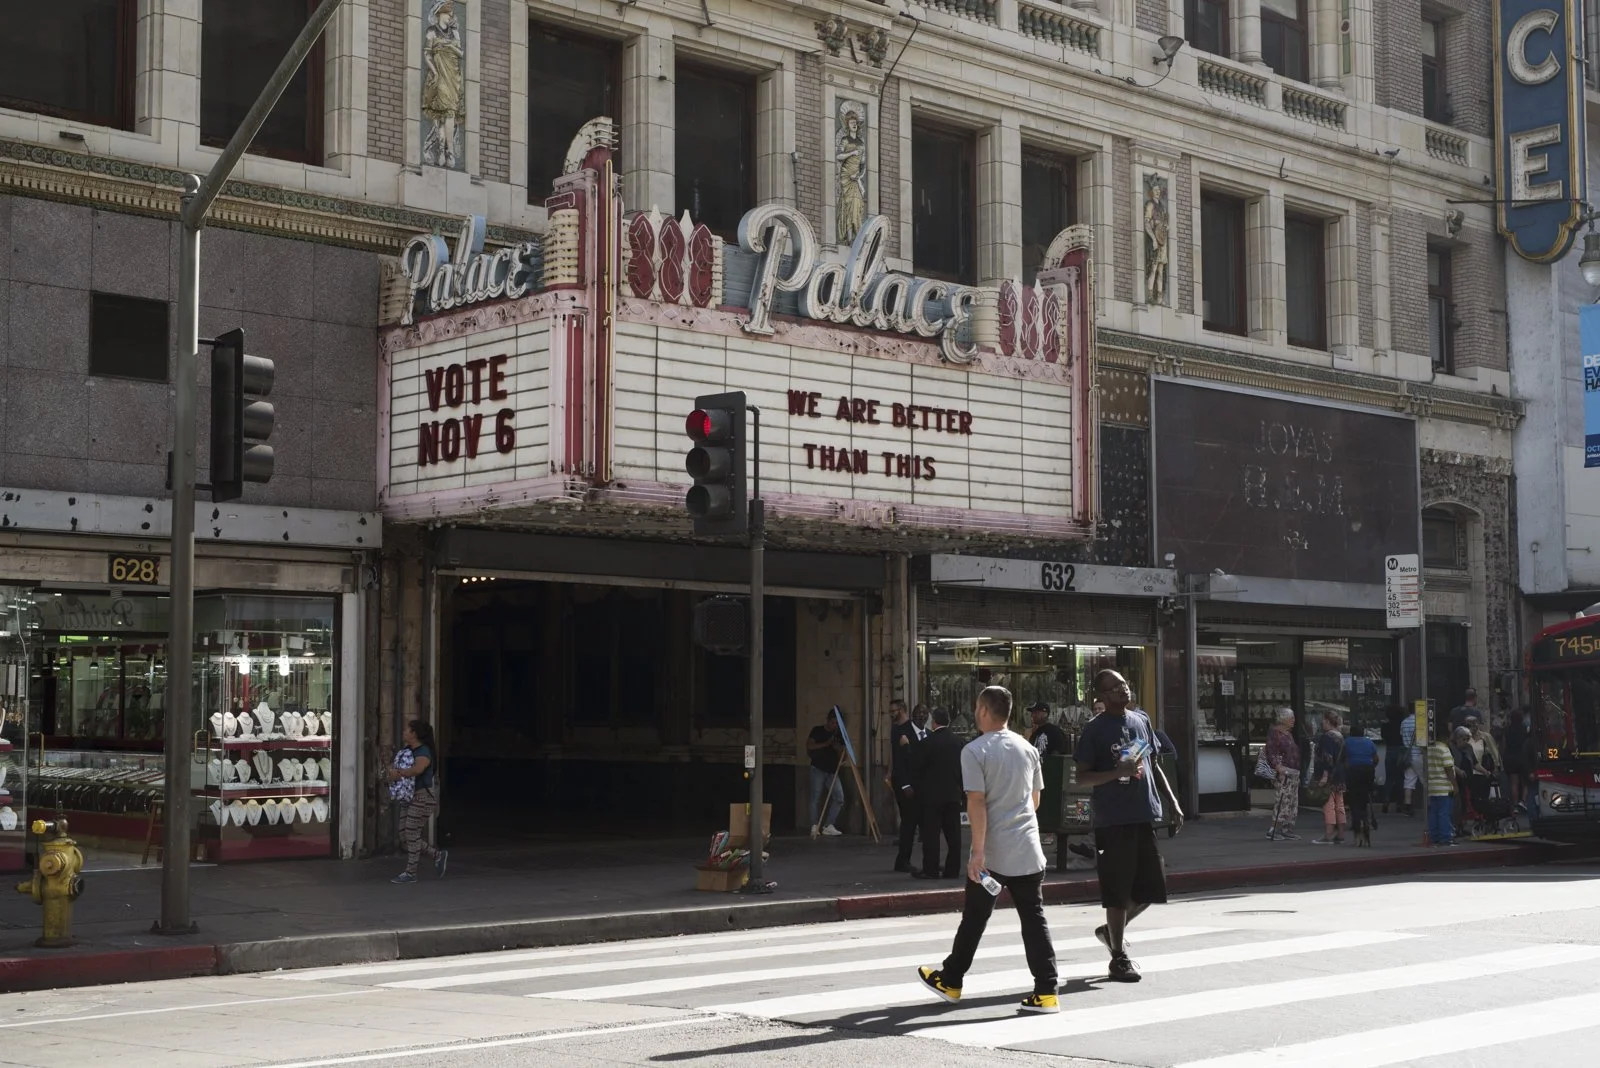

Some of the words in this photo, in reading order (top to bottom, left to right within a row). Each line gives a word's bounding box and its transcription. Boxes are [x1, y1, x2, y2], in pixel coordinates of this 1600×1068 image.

[402, 213, 536, 326] Palace
[737, 203, 984, 364] Palace
[424, 354, 508, 412] VOTE
[787, 389, 822, 418] WE
[836, 396, 881, 425] ARE
[892, 402, 973, 436] BETTER
[418, 413, 483, 467] NOV
[495, 408, 516, 454] 6
[803, 443, 868, 475] THAN
[882, 452, 936, 481] THIS
[112, 557, 154, 582] 628
[1041, 562, 1075, 592] 632
[1387, 577, 1392, 585] 2
[1387, 593, 1397, 601] 45
[1387, 602, 1400, 610] 302
[1388, 610, 1401, 618] 745
[1555, 635, 1593, 657] 745
[1548, 748, 1559, 759] 52
